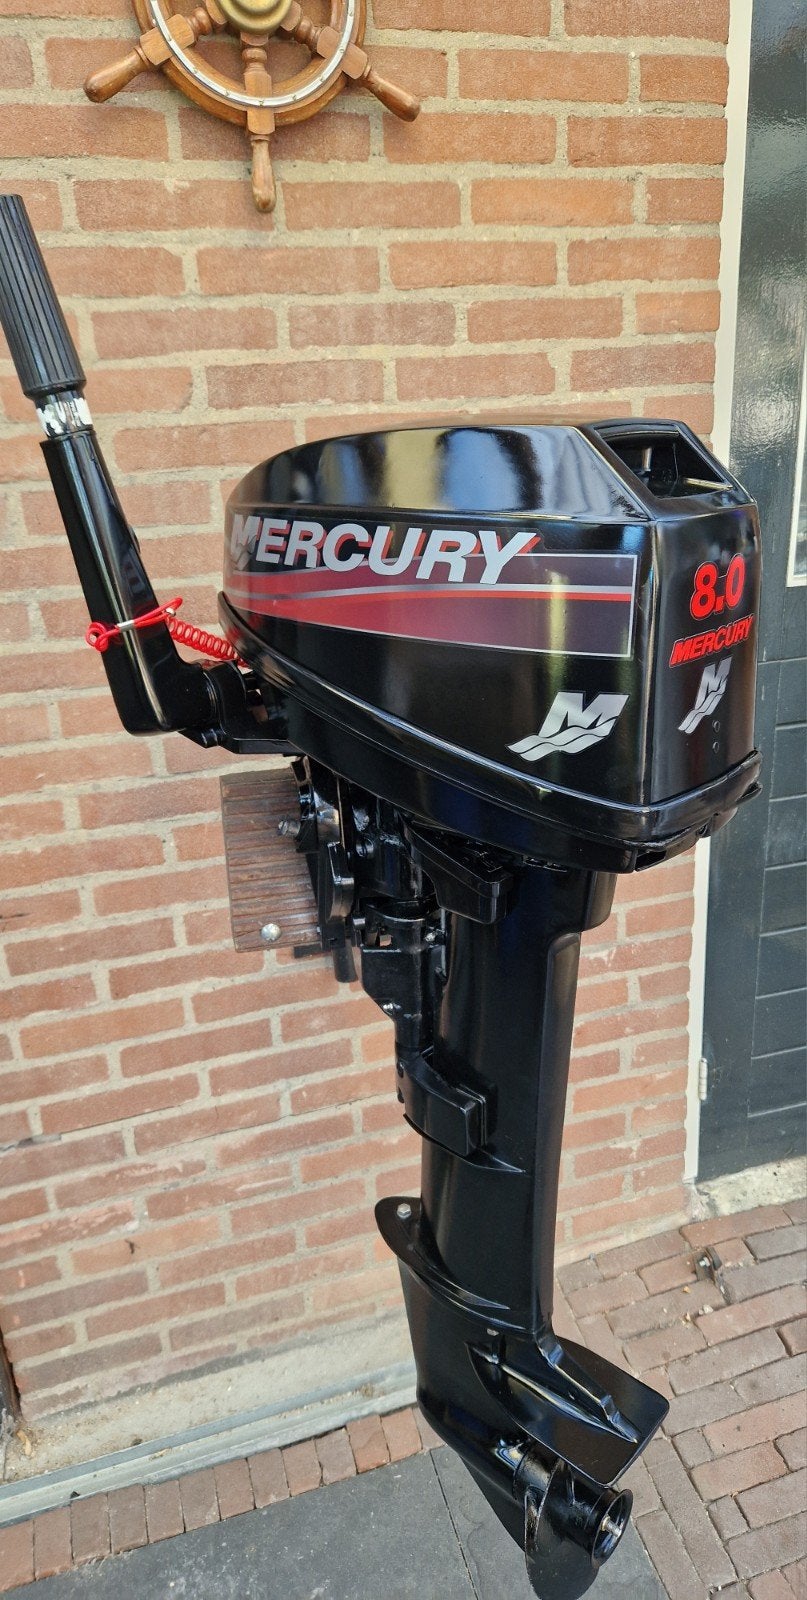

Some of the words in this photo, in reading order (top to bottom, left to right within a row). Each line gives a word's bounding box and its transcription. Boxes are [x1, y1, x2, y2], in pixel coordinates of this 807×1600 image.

[230, 514, 540, 584] MERCURY
[690, 554, 745, 619] 8.0
[670, 615, 753, 666] MERCURY
